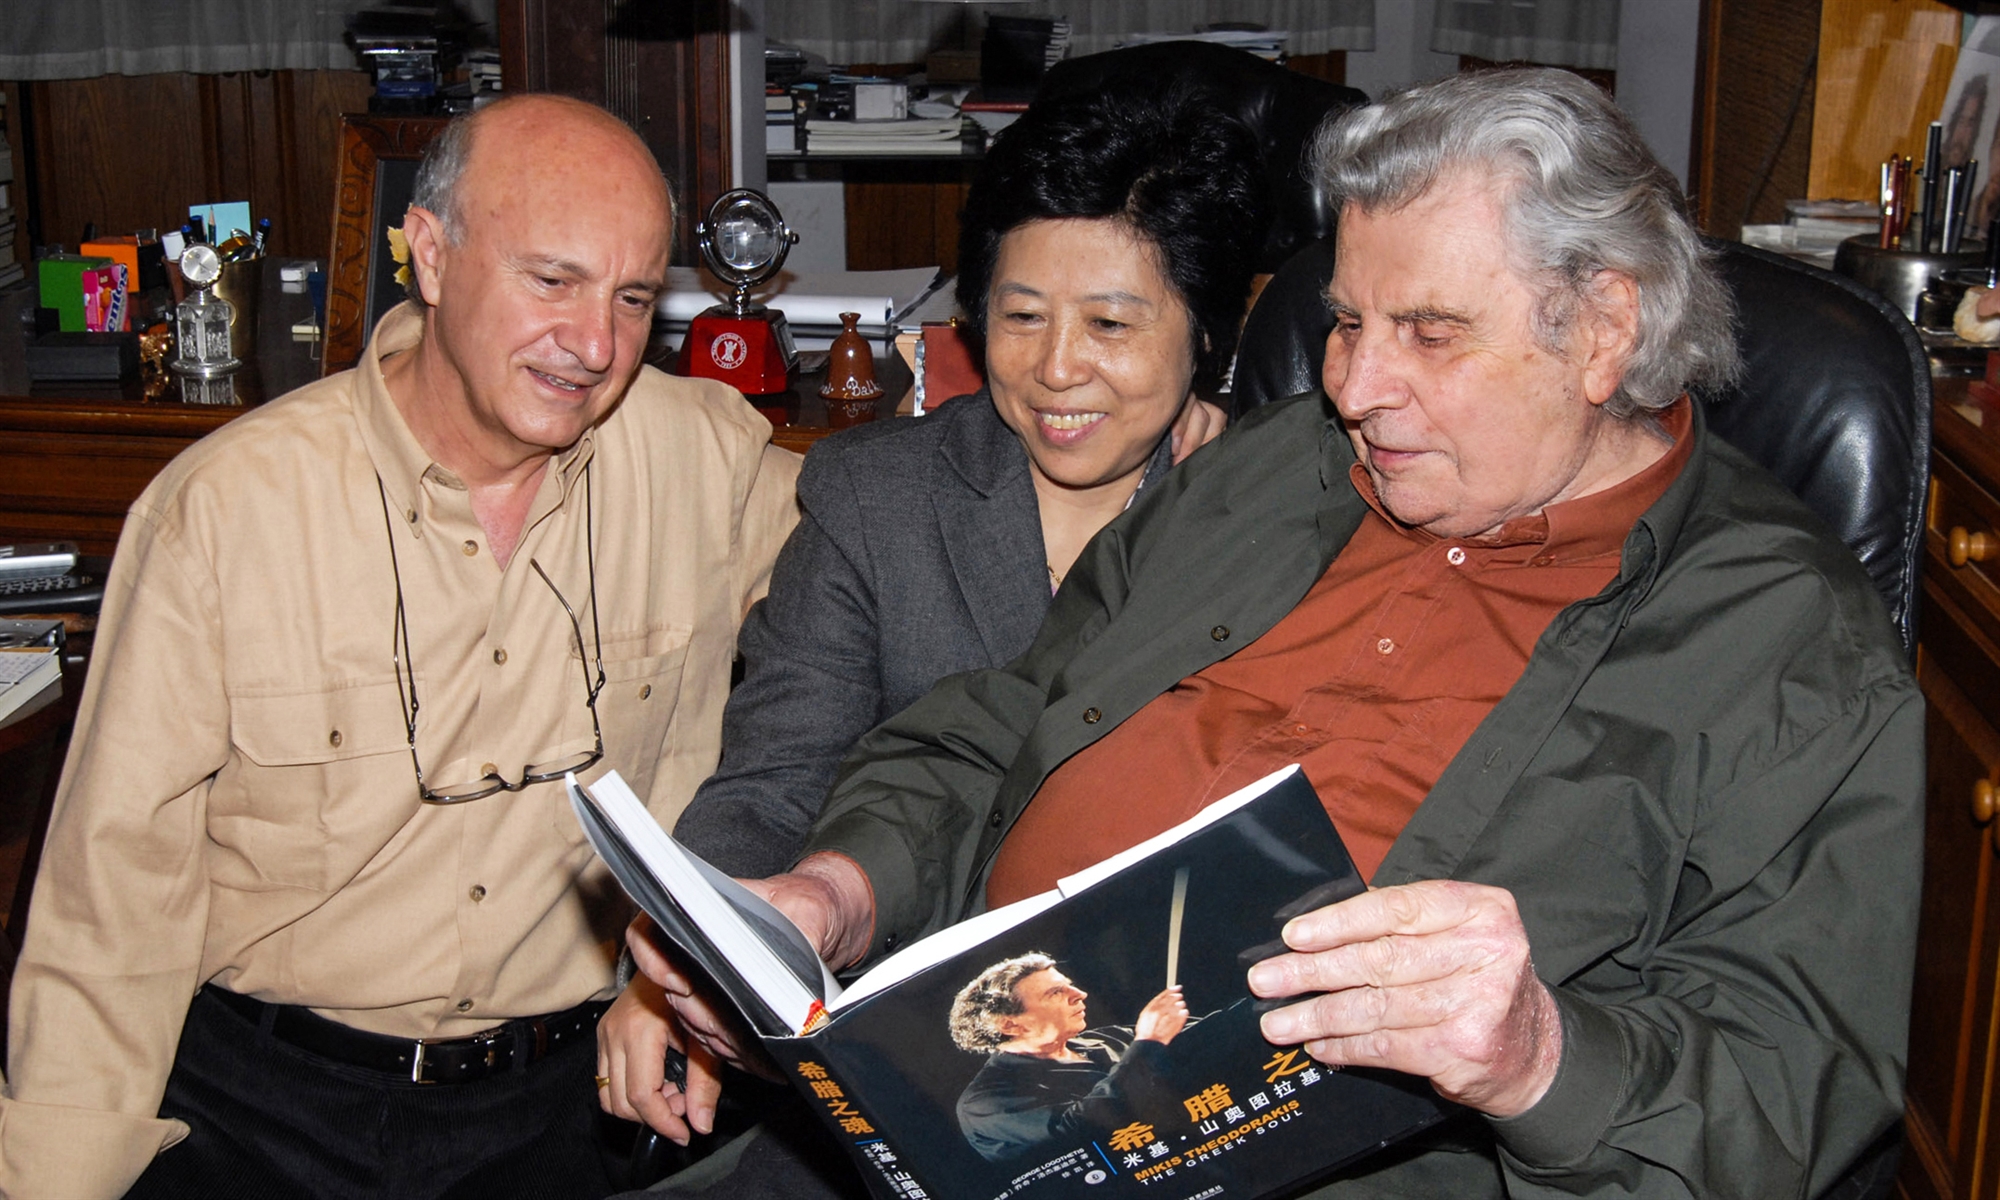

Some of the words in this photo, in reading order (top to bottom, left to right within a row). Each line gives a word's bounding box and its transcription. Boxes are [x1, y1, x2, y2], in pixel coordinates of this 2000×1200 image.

[797, 1061, 875, 1134] 希腊之魂
[1108, 1049, 1310, 1152] 希腊之
[870, 1142, 931, 1200] 米基·山奥图
[1011, 1167, 1041, 1185] GEORGE
[1041, 1147, 1085, 1170] LOGOTHETIS
[1134, 1155, 1182, 1181] MIKIS
[1184, 1099, 1300, 1159] THEODORAKIS
[1140, 1169, 1176, 1186] THE
[1186, 1136, 1247, 1168] GREEK
[1256, 1110, 1304, 1135] SOUL
